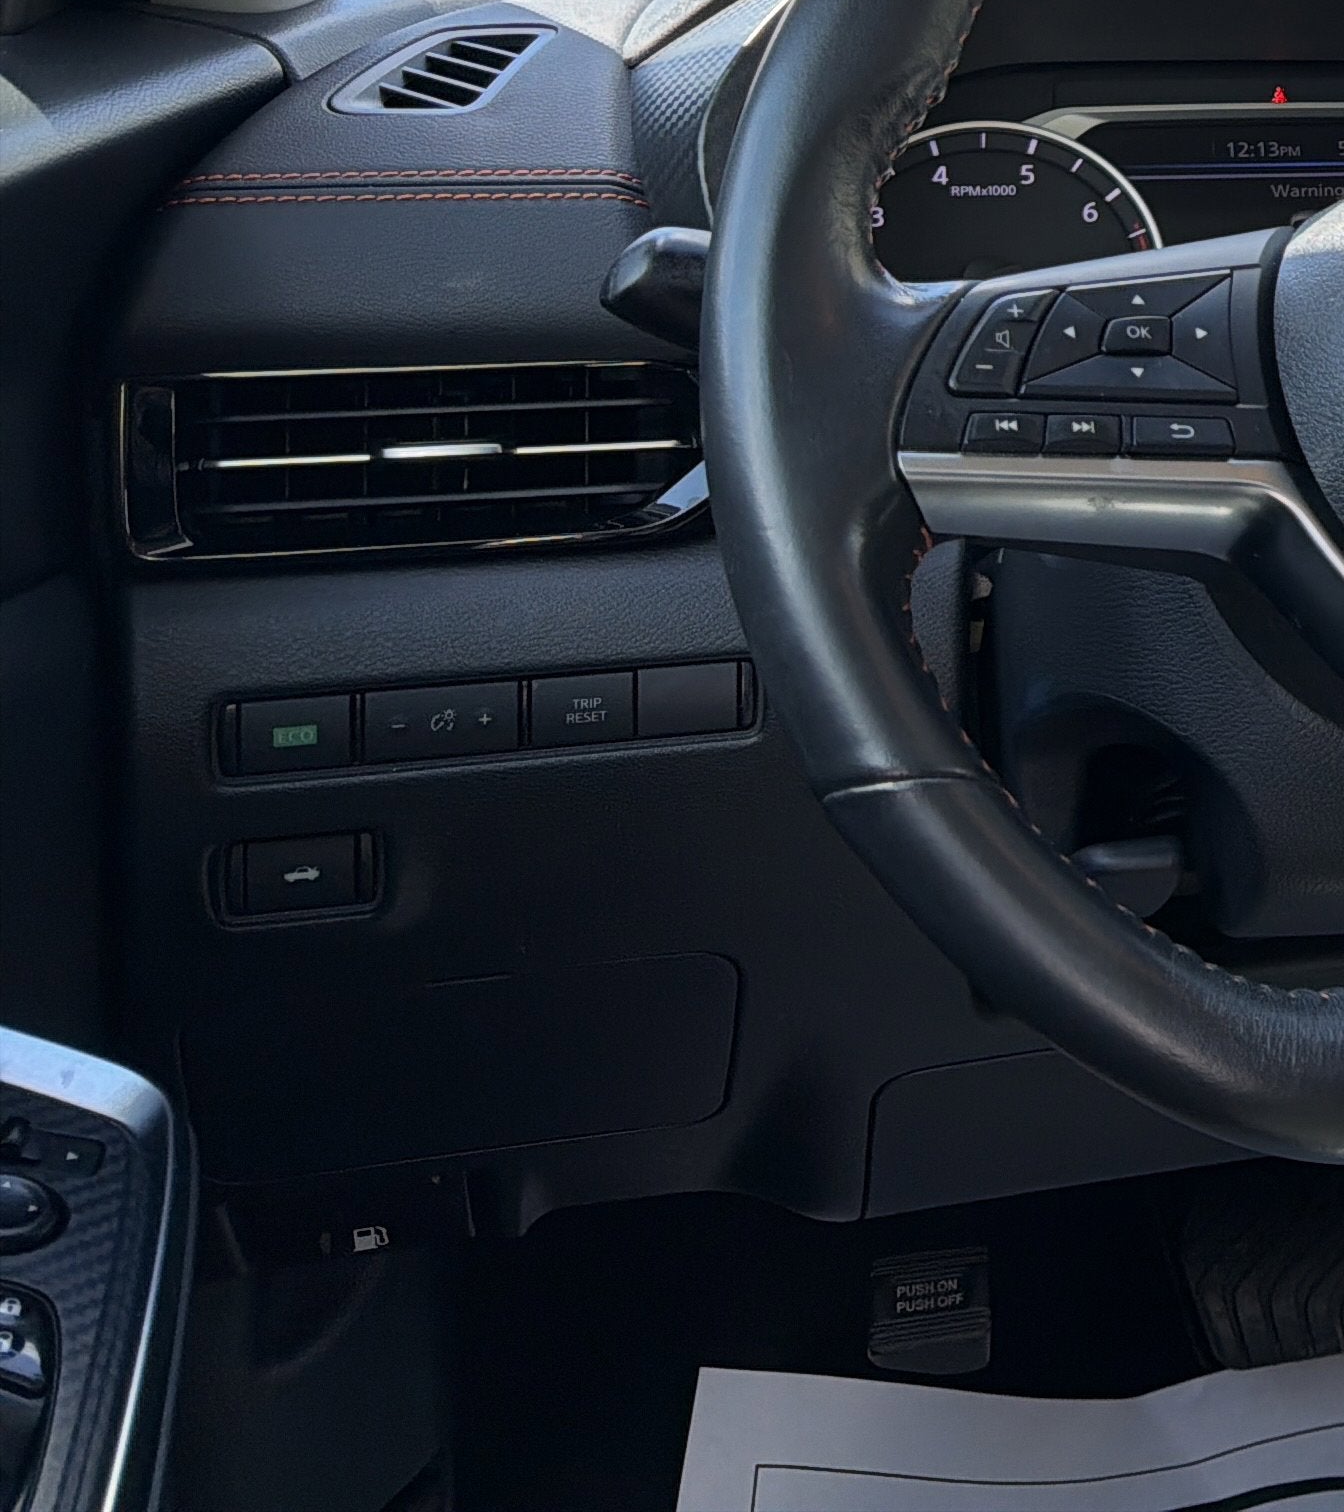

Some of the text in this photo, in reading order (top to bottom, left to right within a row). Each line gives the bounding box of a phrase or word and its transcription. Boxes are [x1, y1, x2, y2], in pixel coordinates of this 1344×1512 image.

[931, 165, 949, 186] 4
[1019, 164, 1035, 185] 5
[950, 185, 1017, 197] RPMx1000
[870, 206, 885, 228] 3
[1082, 201, 1099, 223] 6
[1126, 325, 1152, 339] OK
[572, 697, 602, 709] TRIP
[566, 710, 608, 725] RESET
[897, 1278, 958, 1298] PUSH ON
[896, 1292, 964, 1313] PUSH OFF
